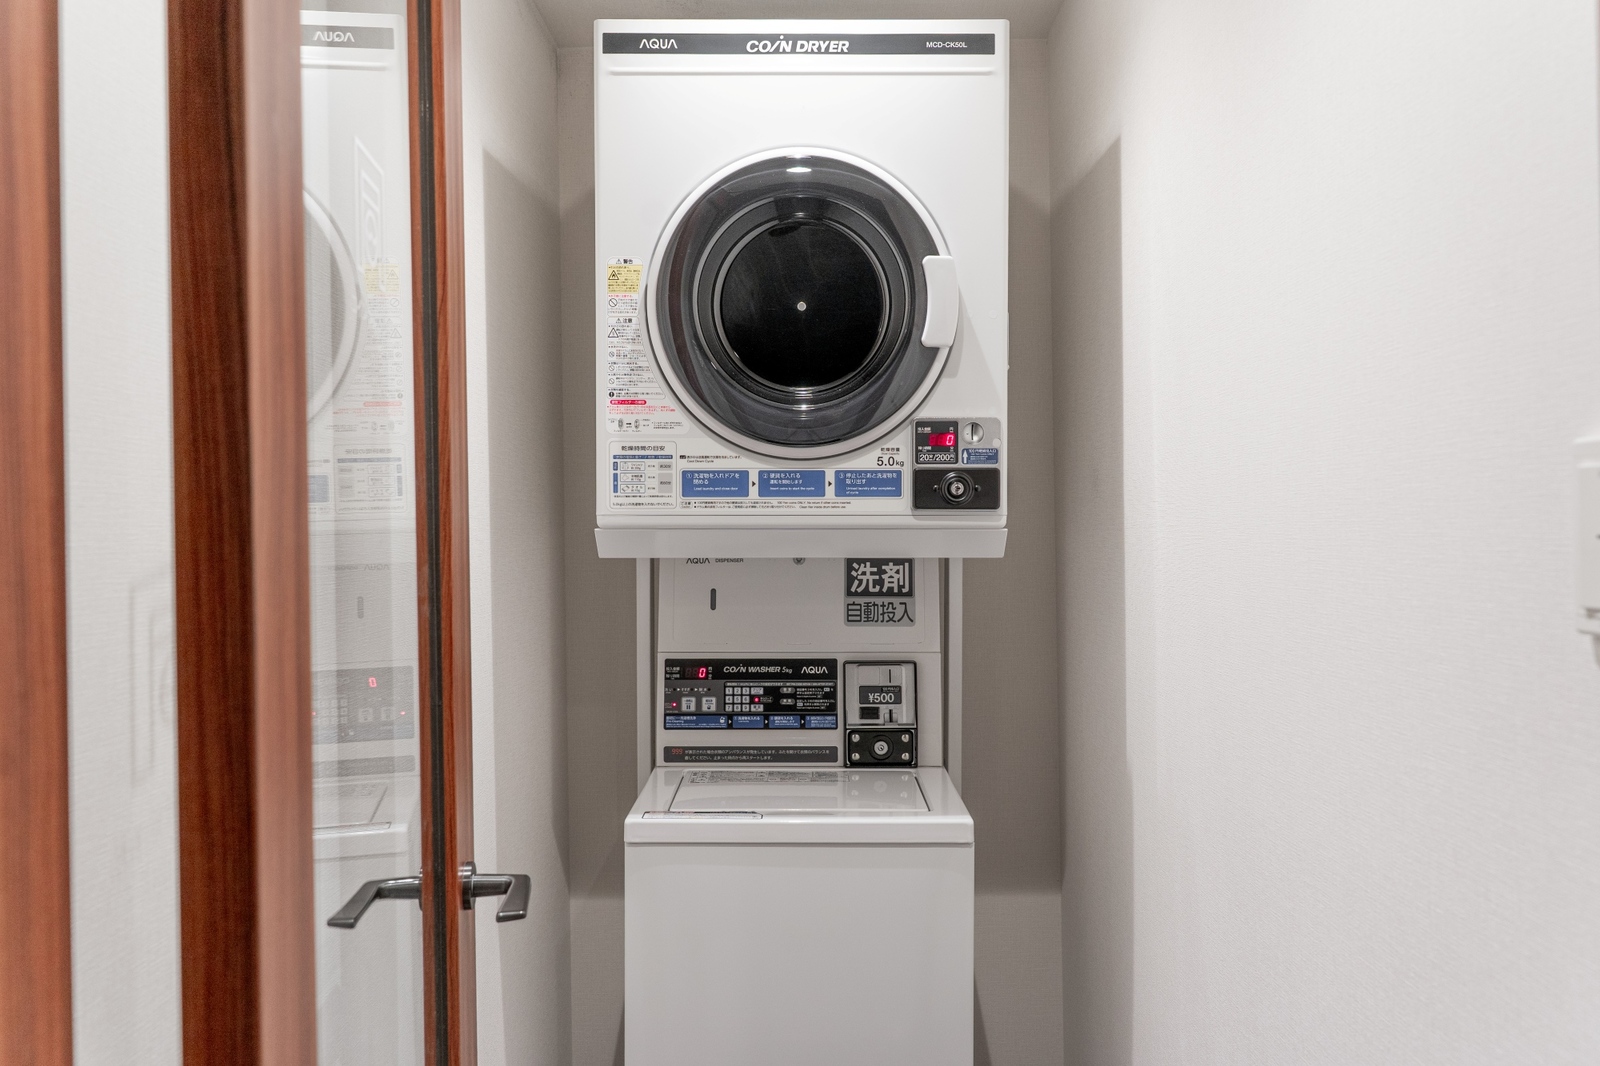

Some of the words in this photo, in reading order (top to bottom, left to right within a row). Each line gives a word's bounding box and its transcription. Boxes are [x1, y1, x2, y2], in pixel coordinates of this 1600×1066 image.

[639, 39, 678, 49] AQUA
[795, 40, 849, 53] DRYER
[946, 434, 954, 446] 0
[850, 562, 911, 593] 洗剤
[846, 601, 914, 623] 自動投入
[699, 668, 706, 678] 0
[801, 666, 828, 674] AQUA
[868, 693, 894, 703] ¥500
